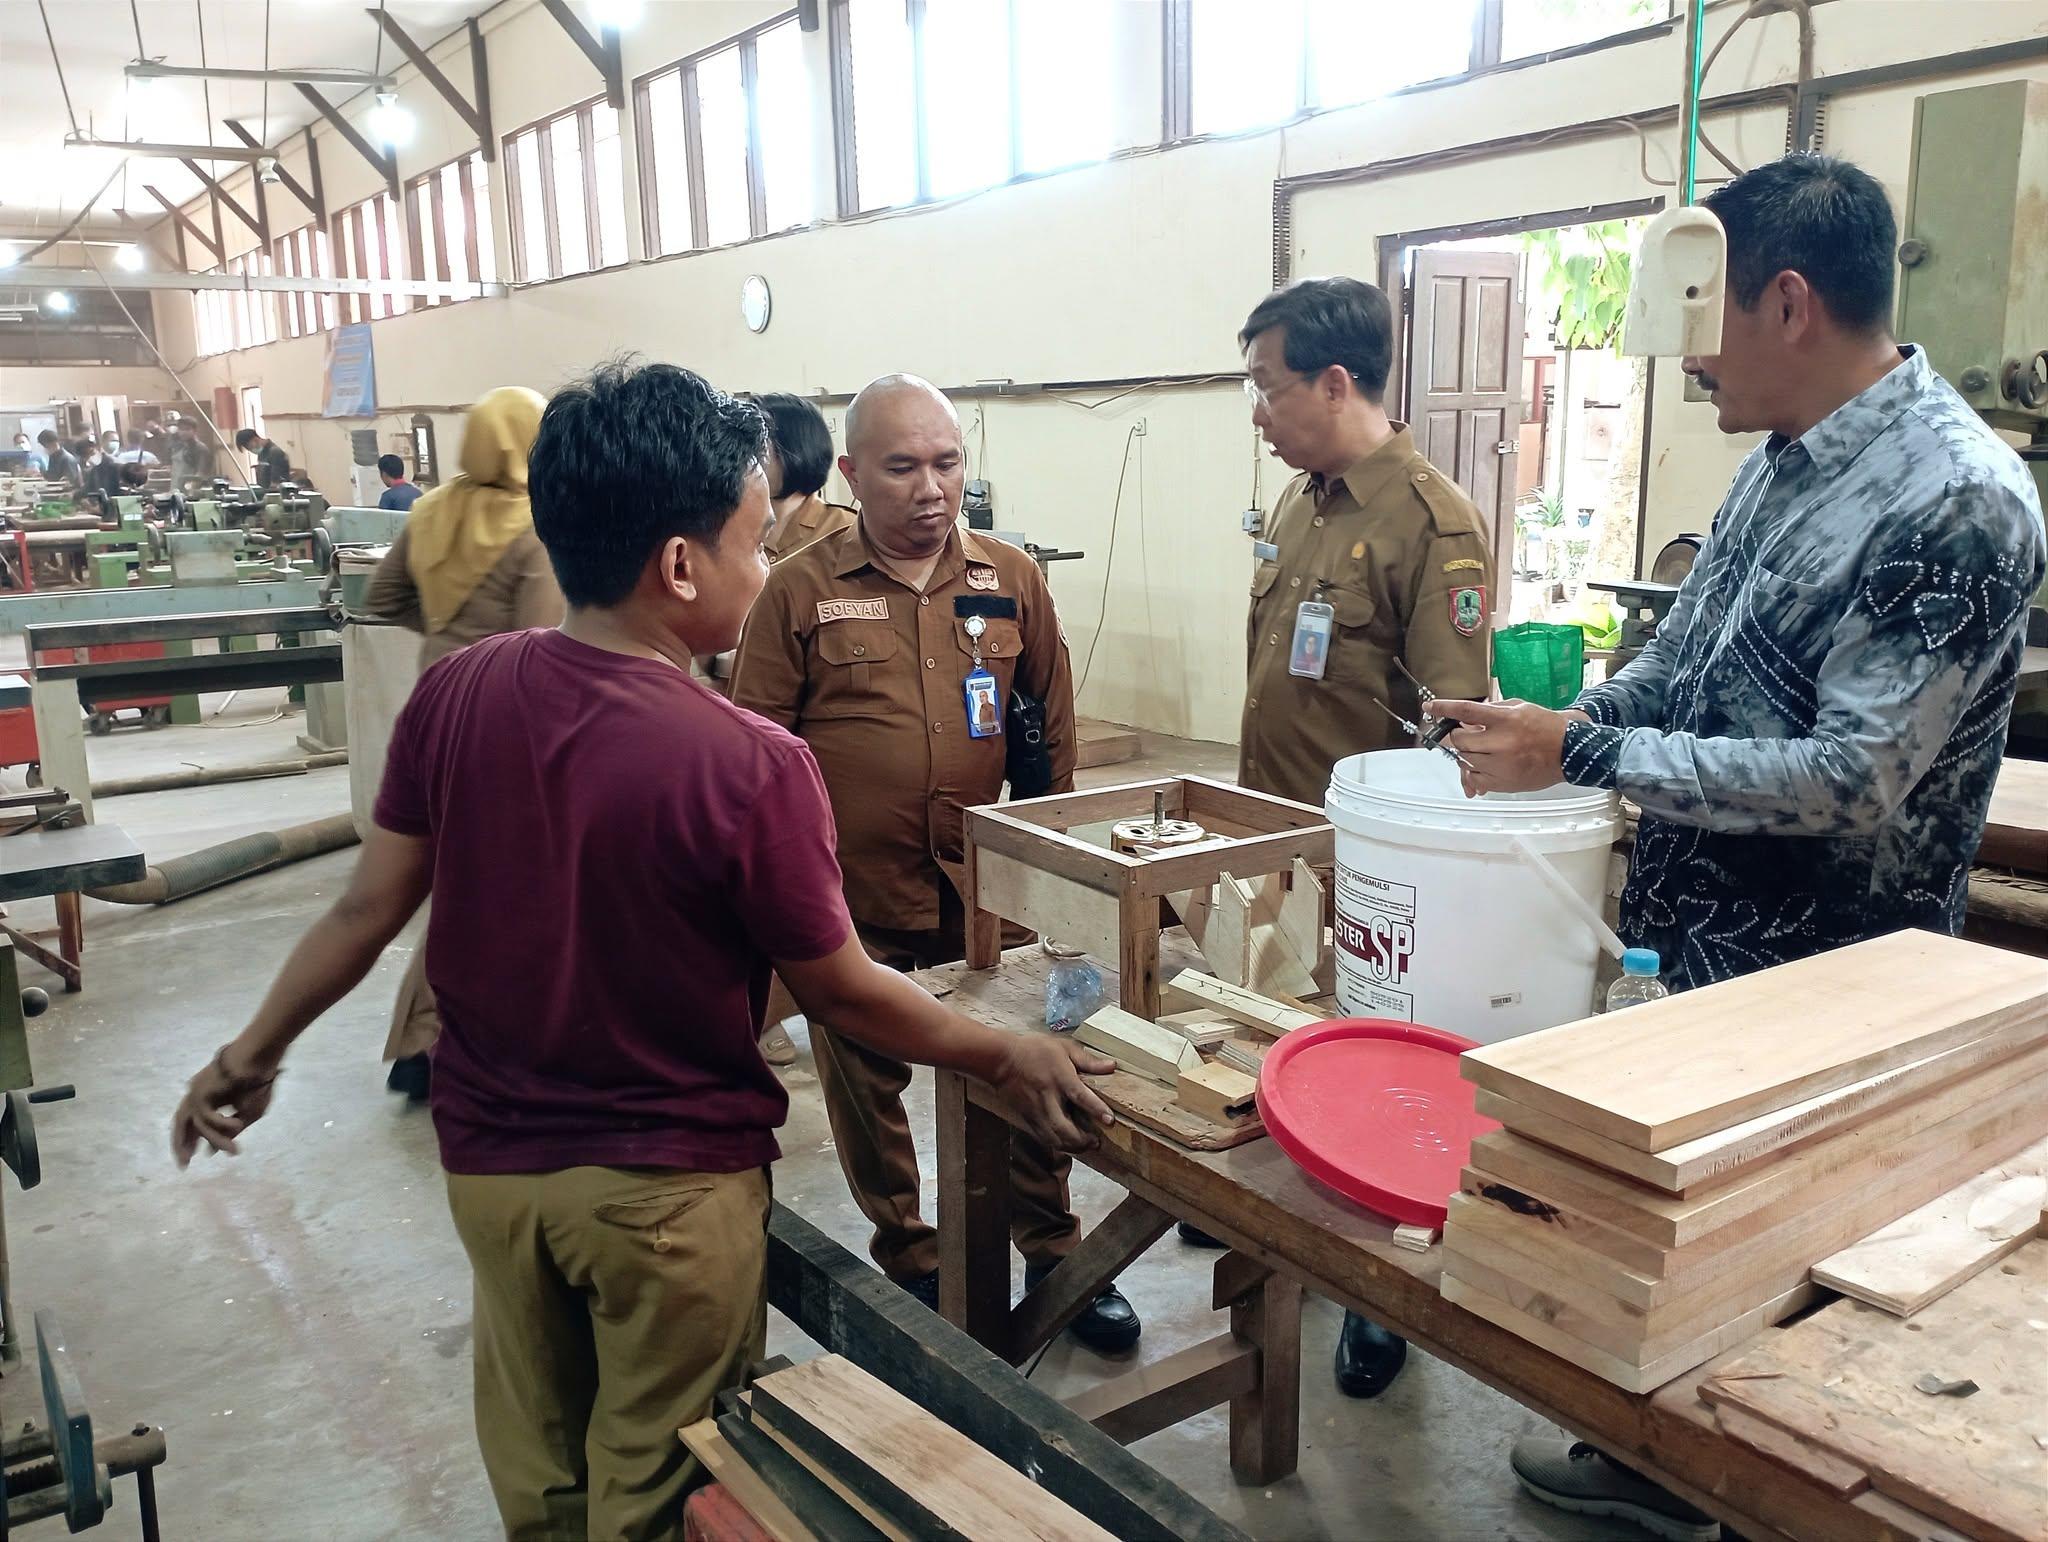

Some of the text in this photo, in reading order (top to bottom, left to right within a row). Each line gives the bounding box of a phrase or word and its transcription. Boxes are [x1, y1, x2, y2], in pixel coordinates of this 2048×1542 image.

[821, 601, 884, 619] SOFYAN
[1352, 873, 1390, 891] PENGEMULSI
[1370, 914, 1415, 985] SP
